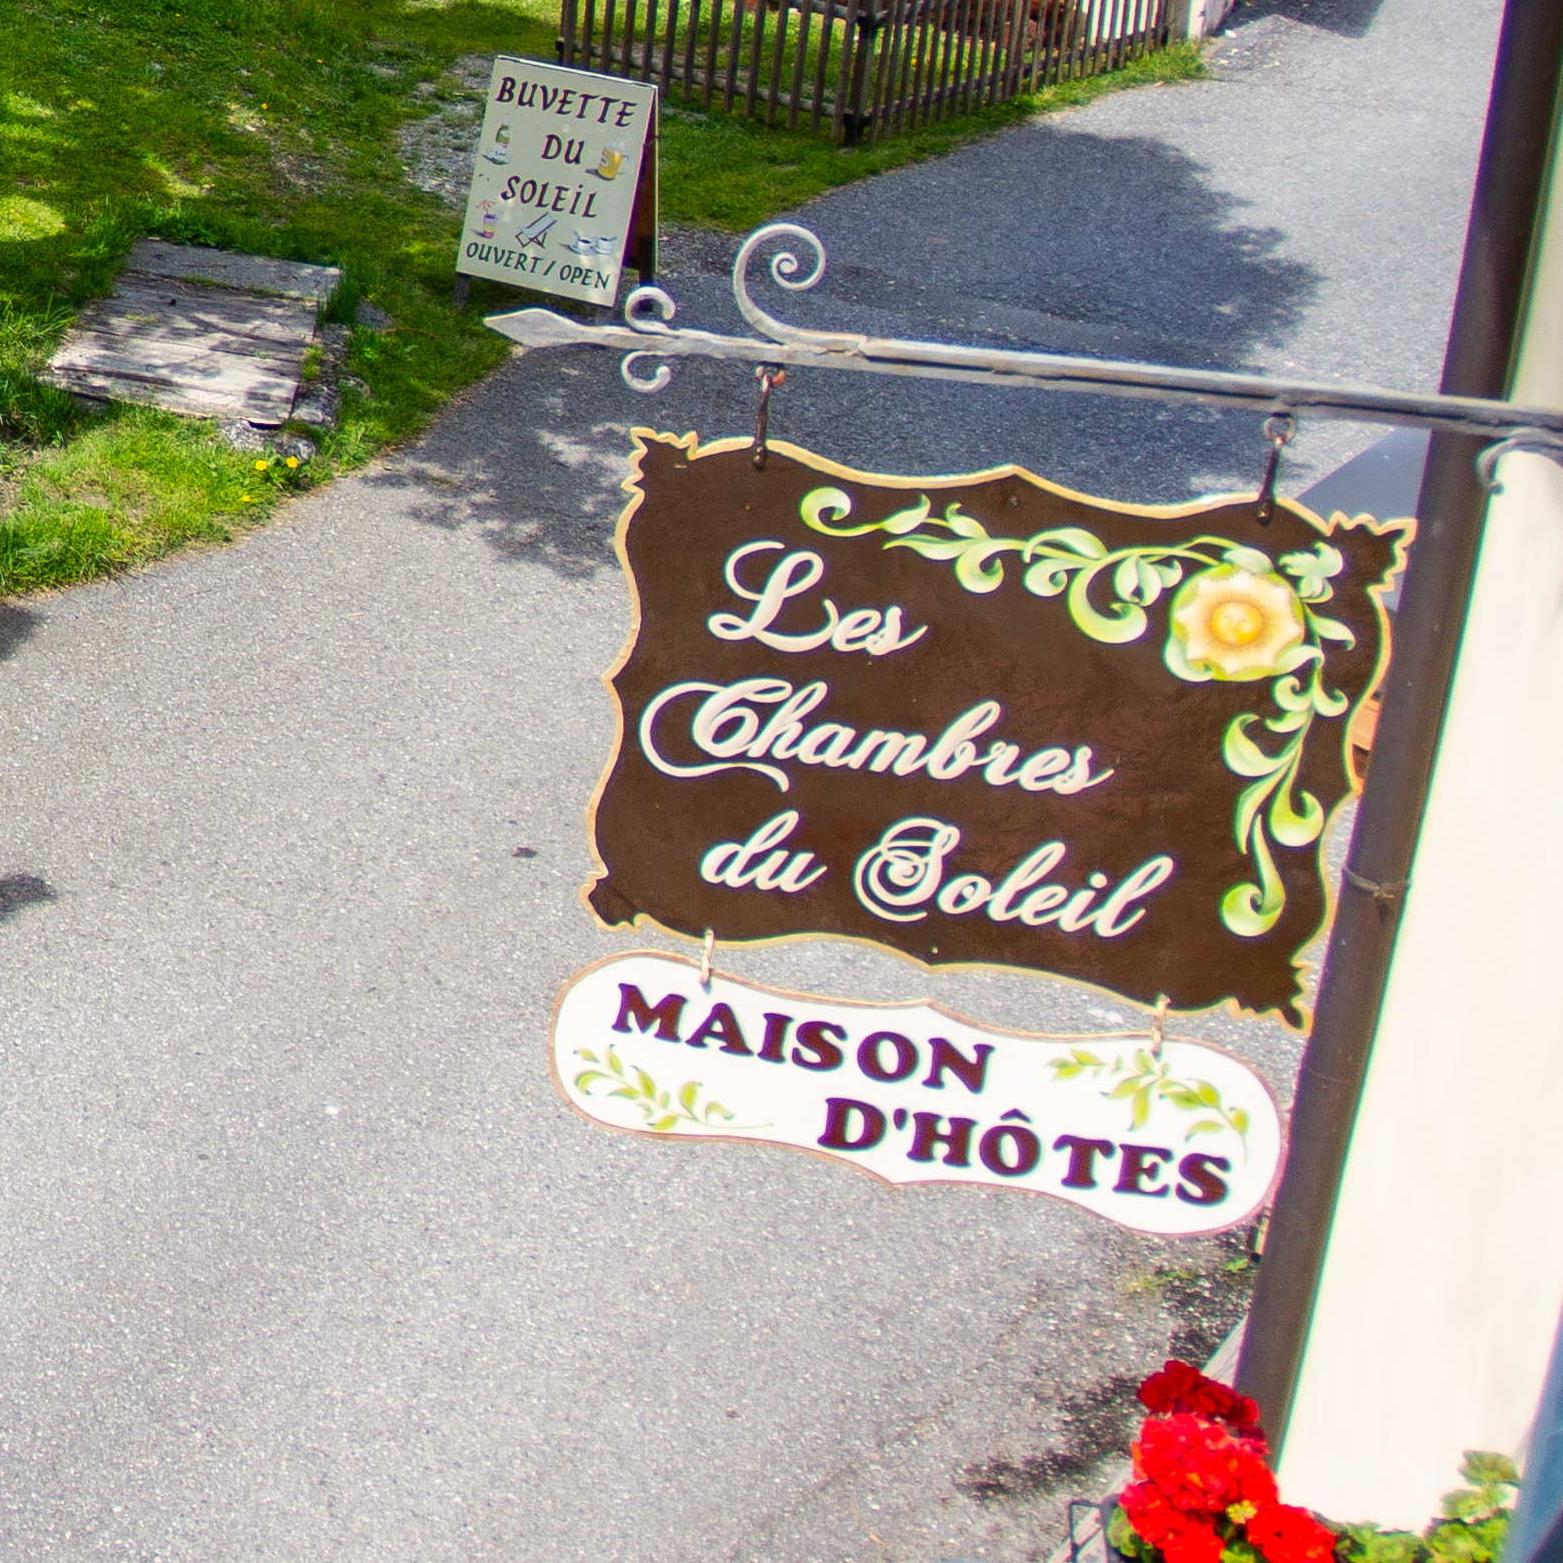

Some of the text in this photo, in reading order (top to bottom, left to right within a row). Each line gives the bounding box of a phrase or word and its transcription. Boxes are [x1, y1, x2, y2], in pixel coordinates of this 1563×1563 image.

[495, 77, 638, 127] BUVETTE
[541, 134, 585, 165] DU
[466, 242, 544, 273] OUVERT
[559, 264, 611, 290] OPEN
[707, 540, 928, 656] Les
[639, 678, 1115, 796] Chambres
[700, 811, 1175, 939] du Soleil
[611, 983, 995, 1096] MAISON
[817, 1097, 1234, 1208] D'HÔTES
